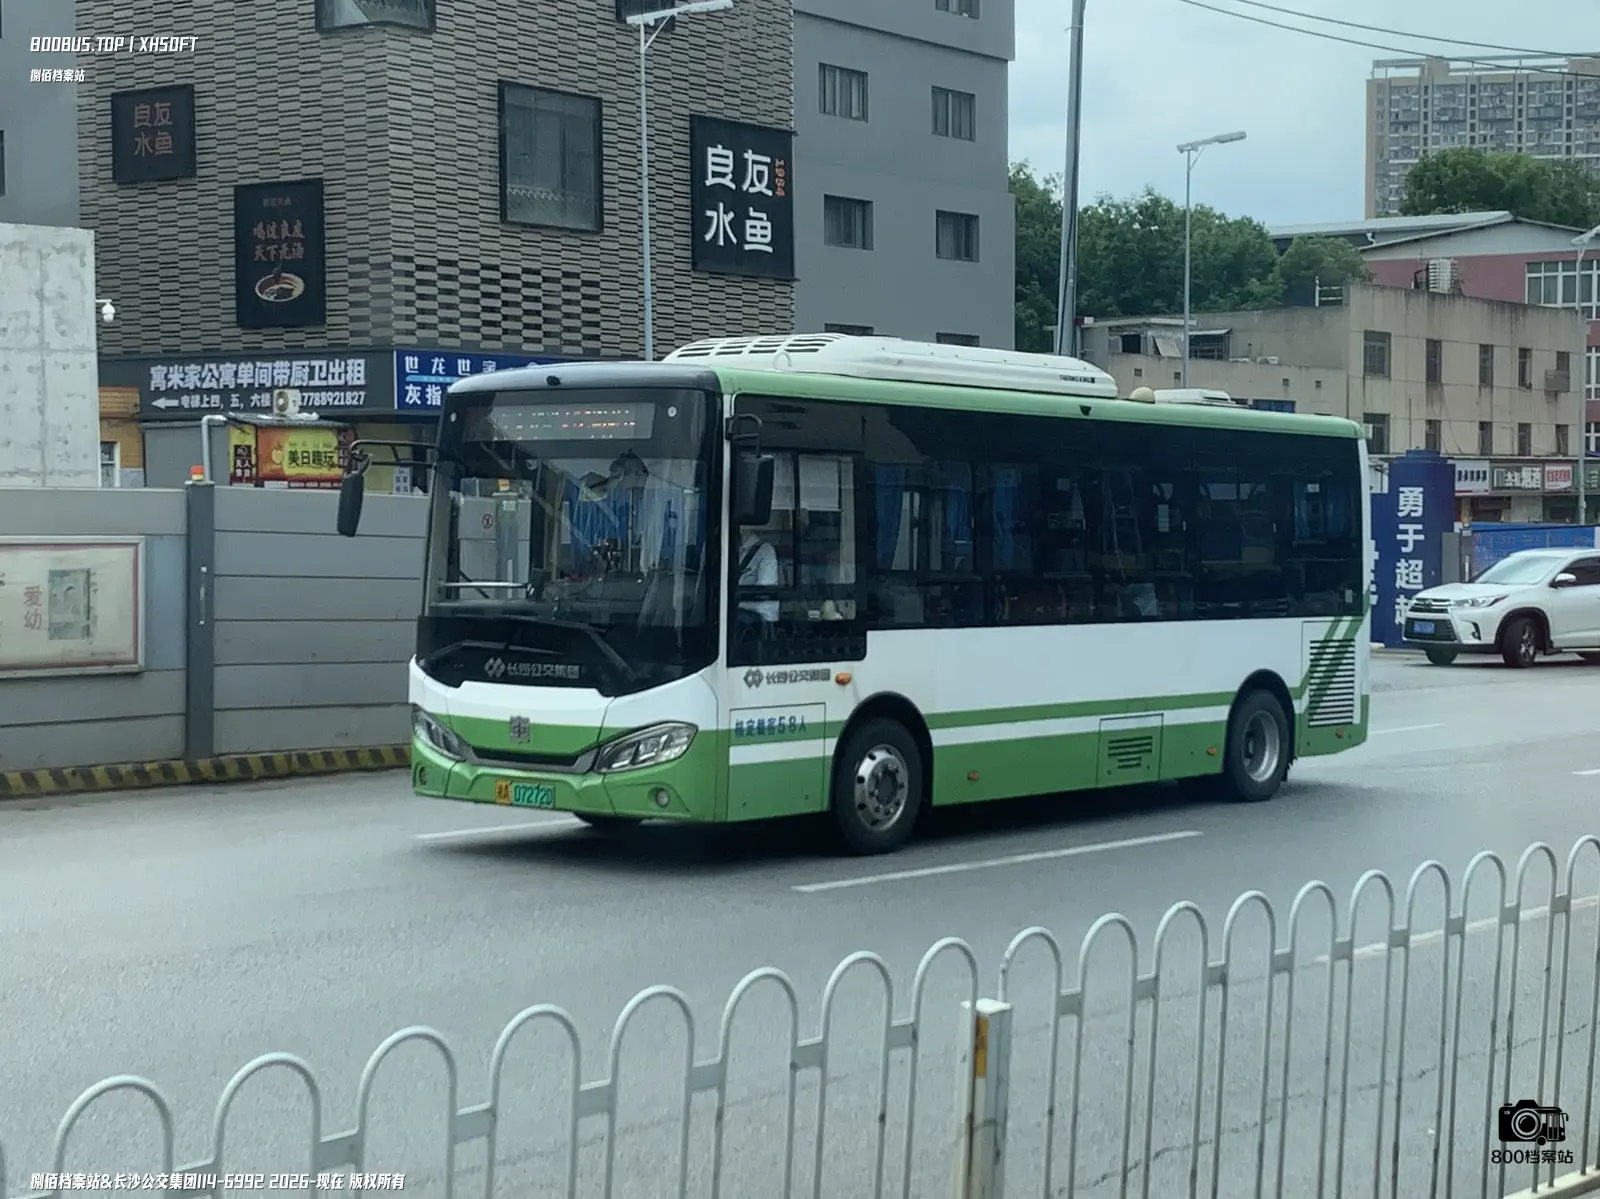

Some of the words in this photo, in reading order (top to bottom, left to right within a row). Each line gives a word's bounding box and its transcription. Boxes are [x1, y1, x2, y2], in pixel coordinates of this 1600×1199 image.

[134, 102, 173, 128] 良友
[134, 130, 173, 157] 水鱼
[705, 144, 773, 197] 良友
[704, 202, 773, 253] 水鱼
[405, 384, 449, 406] 灰指
